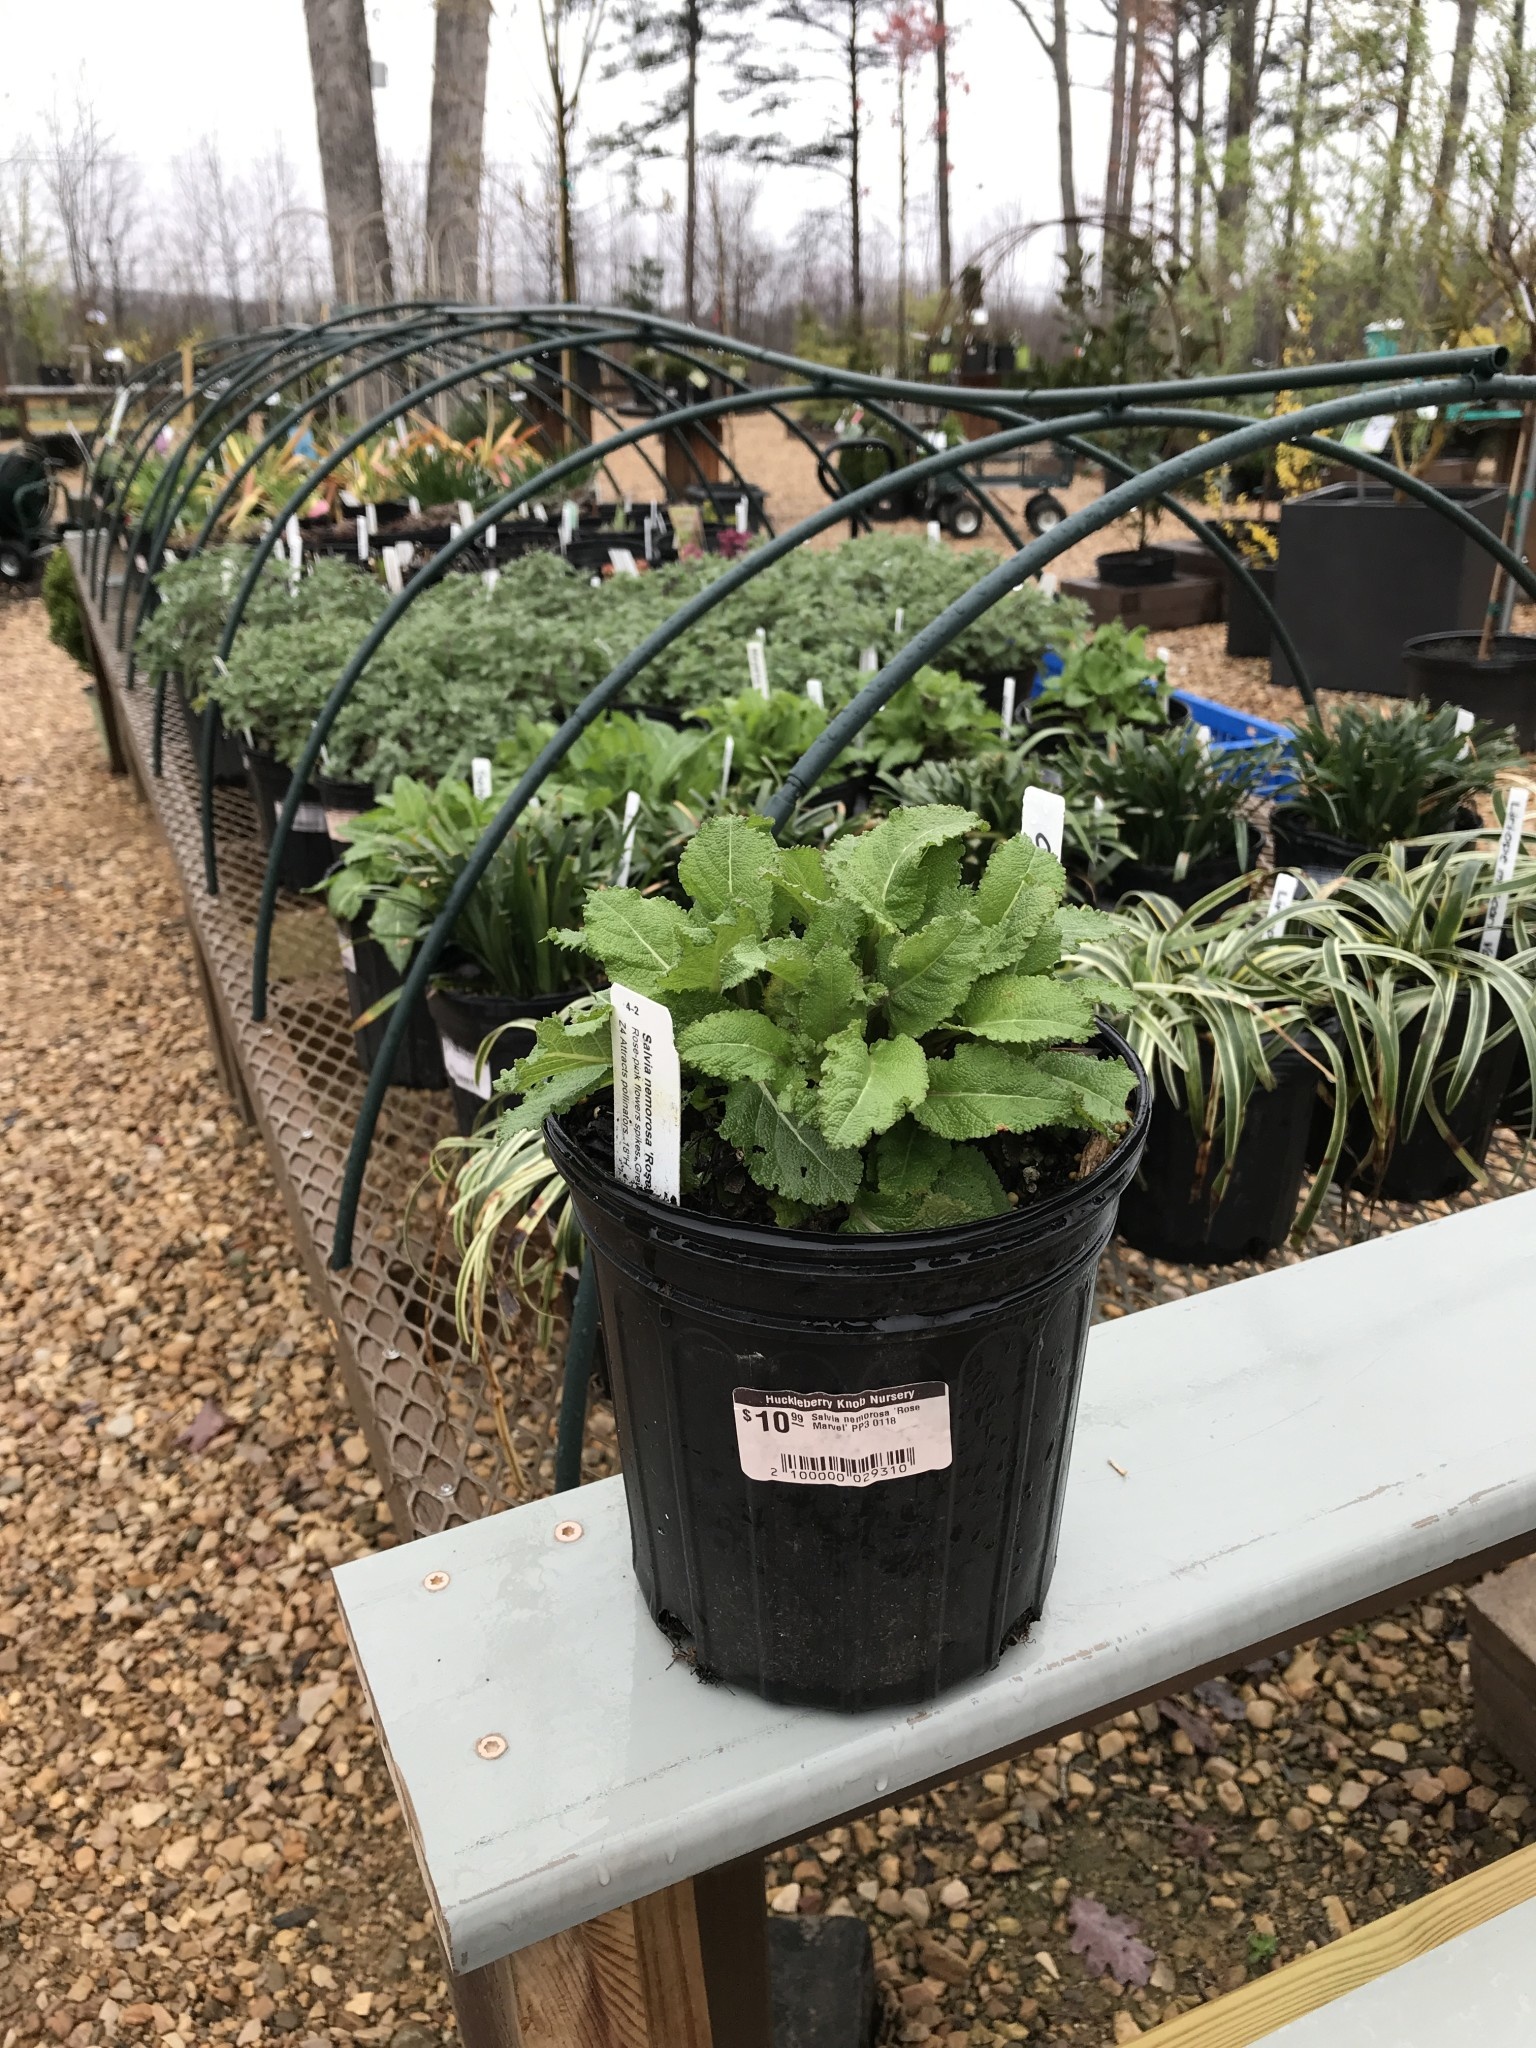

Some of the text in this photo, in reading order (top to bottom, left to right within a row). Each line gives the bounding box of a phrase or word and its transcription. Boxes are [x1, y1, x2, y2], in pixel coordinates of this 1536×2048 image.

[620, 1036, 629, 1078] Attracts
[631, 1026, 642, 1081] Rose-pink
[642, 1032, 653, 1075] Salvia
[634, 1083, 642, 1122] flowers
[644, 1077, 653, 1147] nemorosa
[765, 1389, 915, 1409] Huckleberry Knob Nursery
[811, 1412, 840, 1423] Salvia
[843, 1410, 890, 1424] nemorosa
[872, 1416, 897, 1427] 0118
